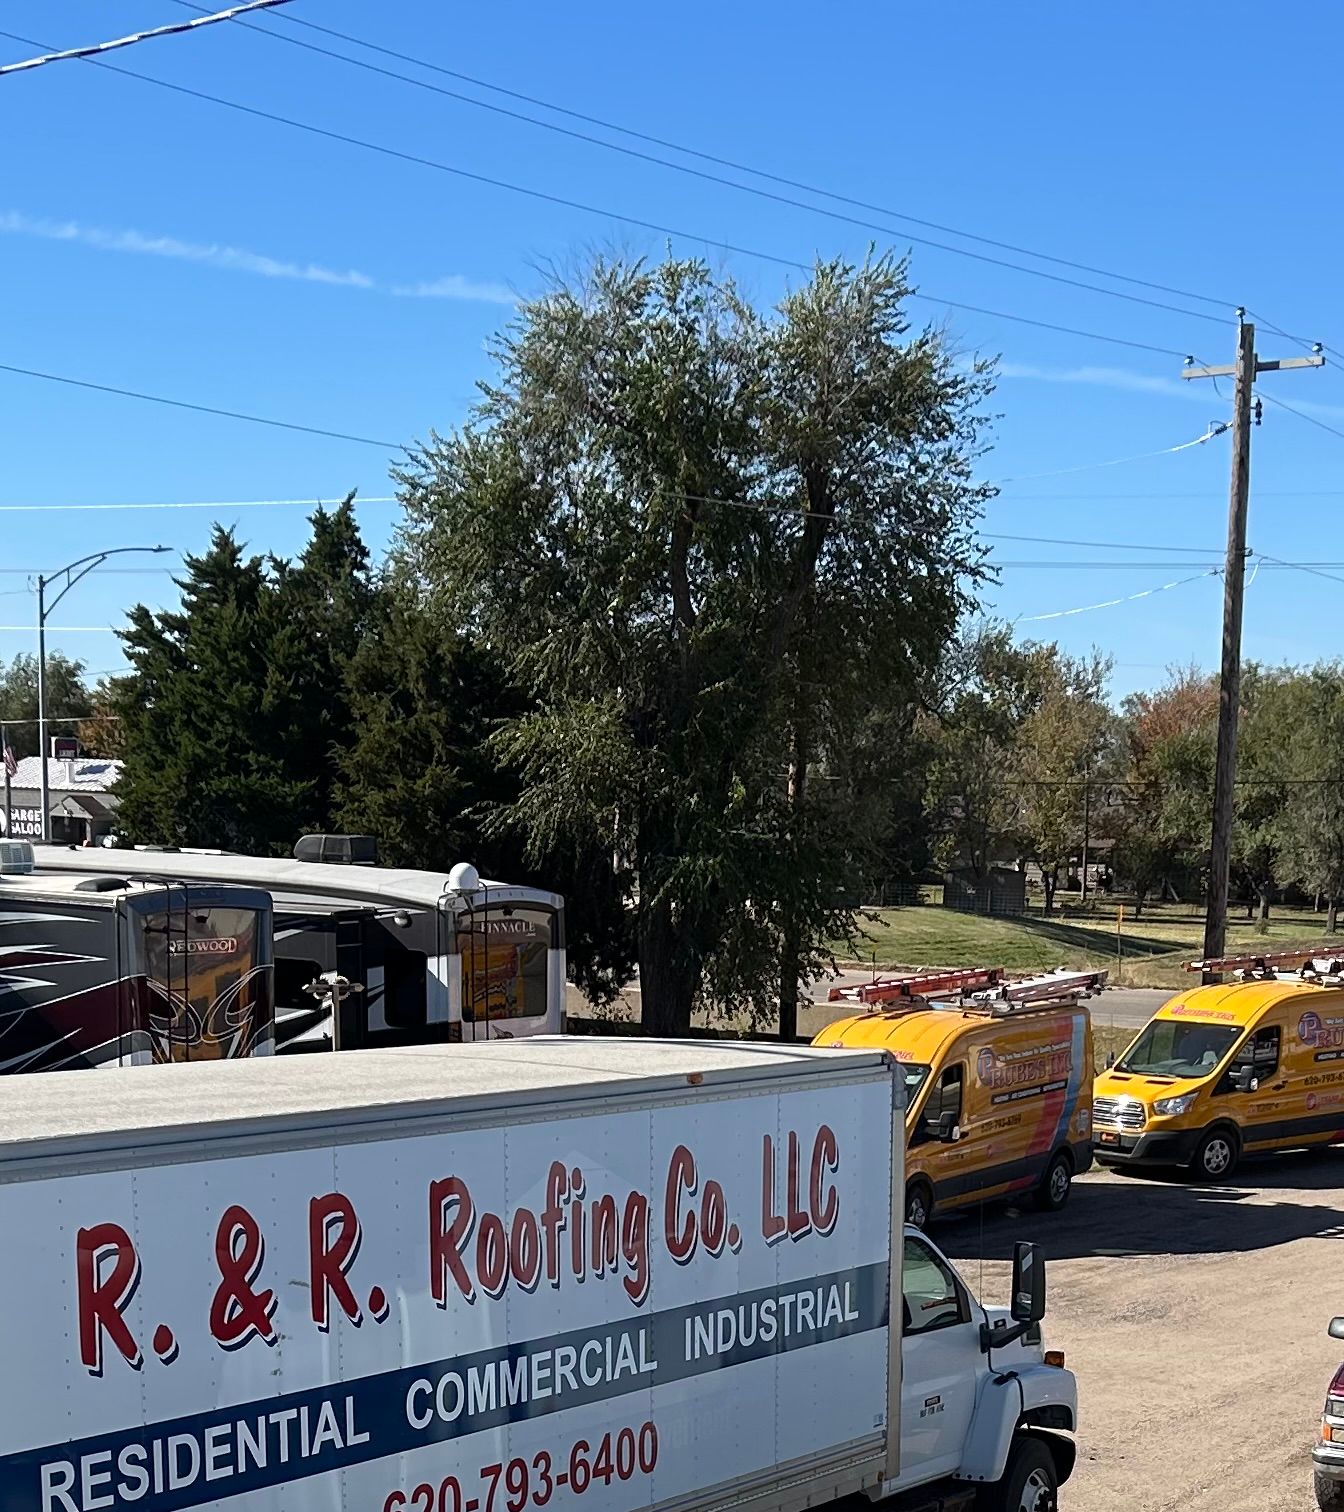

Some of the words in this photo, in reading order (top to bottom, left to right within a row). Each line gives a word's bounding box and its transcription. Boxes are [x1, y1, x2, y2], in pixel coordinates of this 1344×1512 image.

[11, 821, 42, 835] SALOO
[77, 1222, 180, 1378] R.
[209, 1204, 278, 1352] &
[309, 1192, 390, 1332] R.
[429, 1160, 650, 1308] Roofing
[664, 1145, 742, 1266] Co.
[761, 1124, 840, 1246] LLC
[405, 1332, 657, 1431] COMMERCIAL
[683, 1280, 860, 1363] INDUSTRIAL
